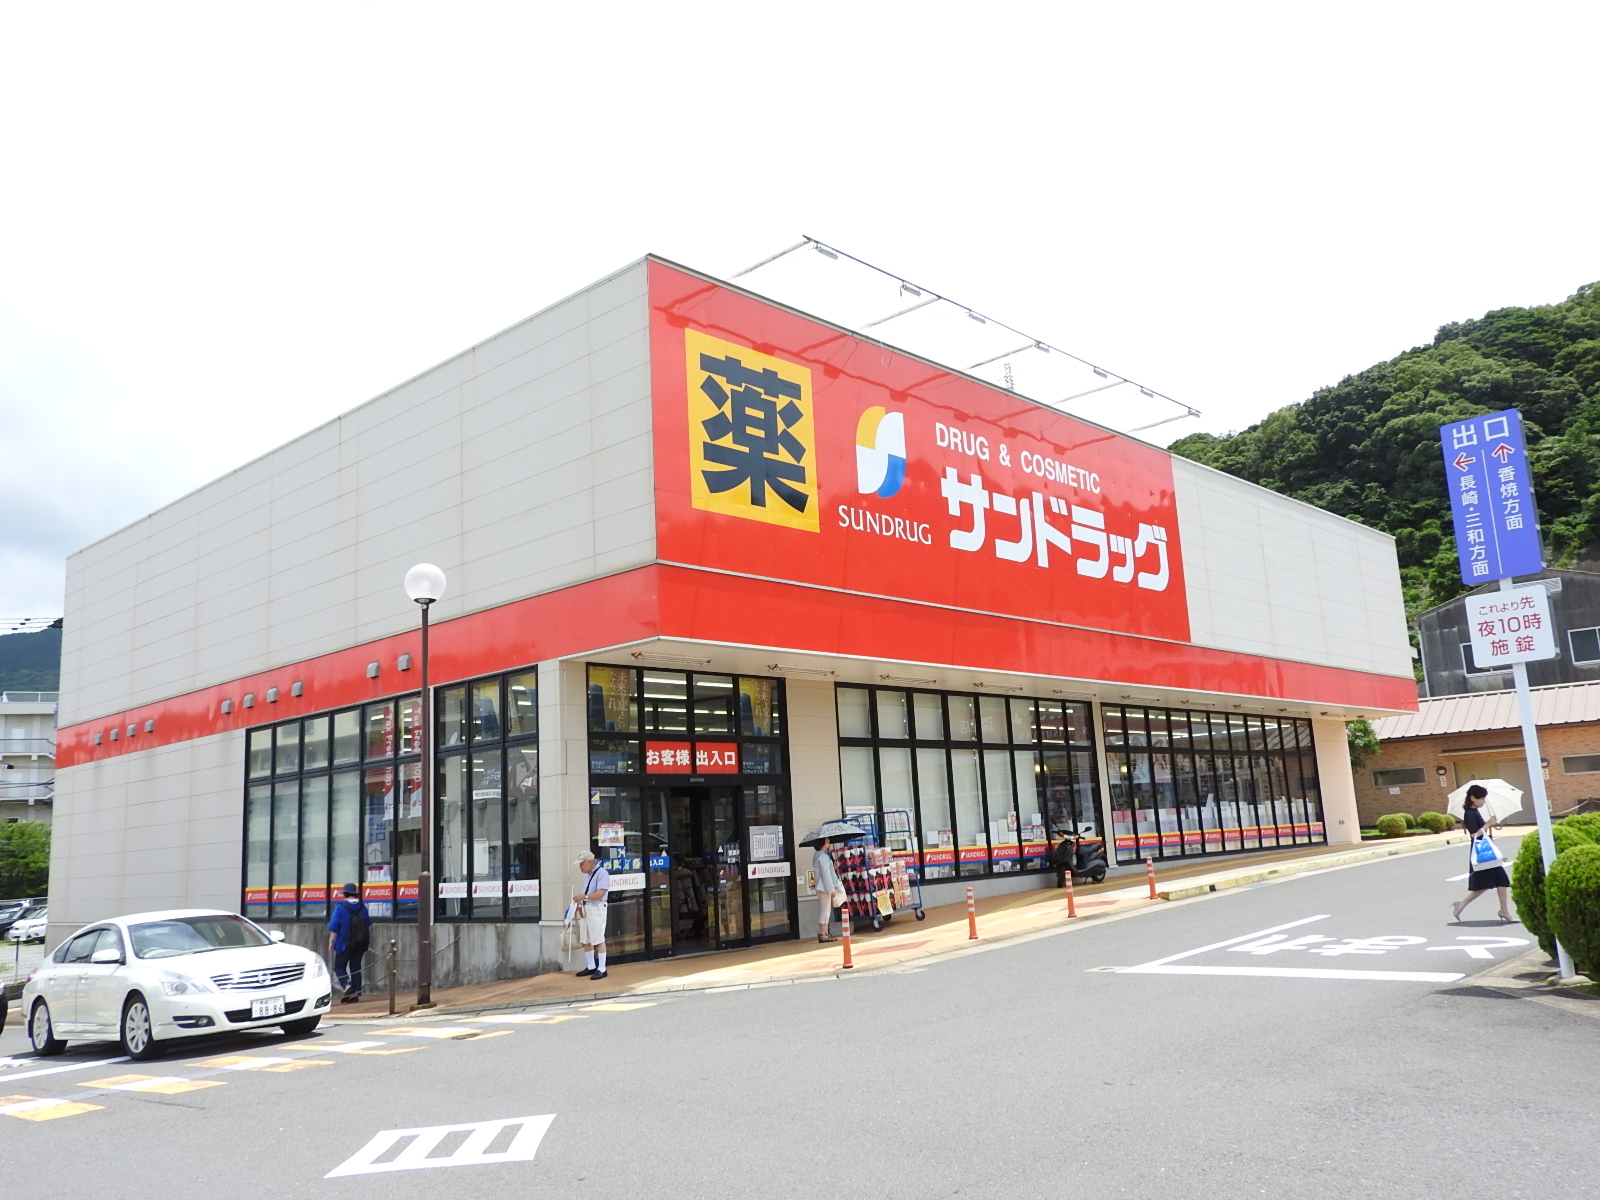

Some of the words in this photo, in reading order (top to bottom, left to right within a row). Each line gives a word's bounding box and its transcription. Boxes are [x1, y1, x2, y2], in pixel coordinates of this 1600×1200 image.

[699, 353, 810, 514] 薬
[1453, 416, 1509, 449] 出口
[935, 422, 989, 461] DRUG
[1000, 443, 1011, 467] &
[1021, 450, 1100, 494] COSMETIC
[1498, 466, 1523, 530] 香焼方面
[838, 505, 932, 545] SUNDRUG
[941, 466, 1169, 591] サンドラッグ
[1460, 475, 1489, 576] 長崎・三和方面
[1479, 596, 1535, 615] これより先
[1477, 613, 1541, 637] 夜10時
[1490, 635, 1535, 656] 施錠
[385, 712, 393, 732] Tax
[413, 708, 421, 727] Tax
[646, 749, 690, 766] お客様
[696, 750, 736, 766] 出入口
[413, 761, 422, 782] hop
[376, 822, 386, 841] 出口
[757, 865, 785, 874] SUNDRUG
[609, 877, 639, 886] UNDRUG
[1226, 934, 1530, 959] とまれ
[259, 1003, 283, 1015] 88-86
